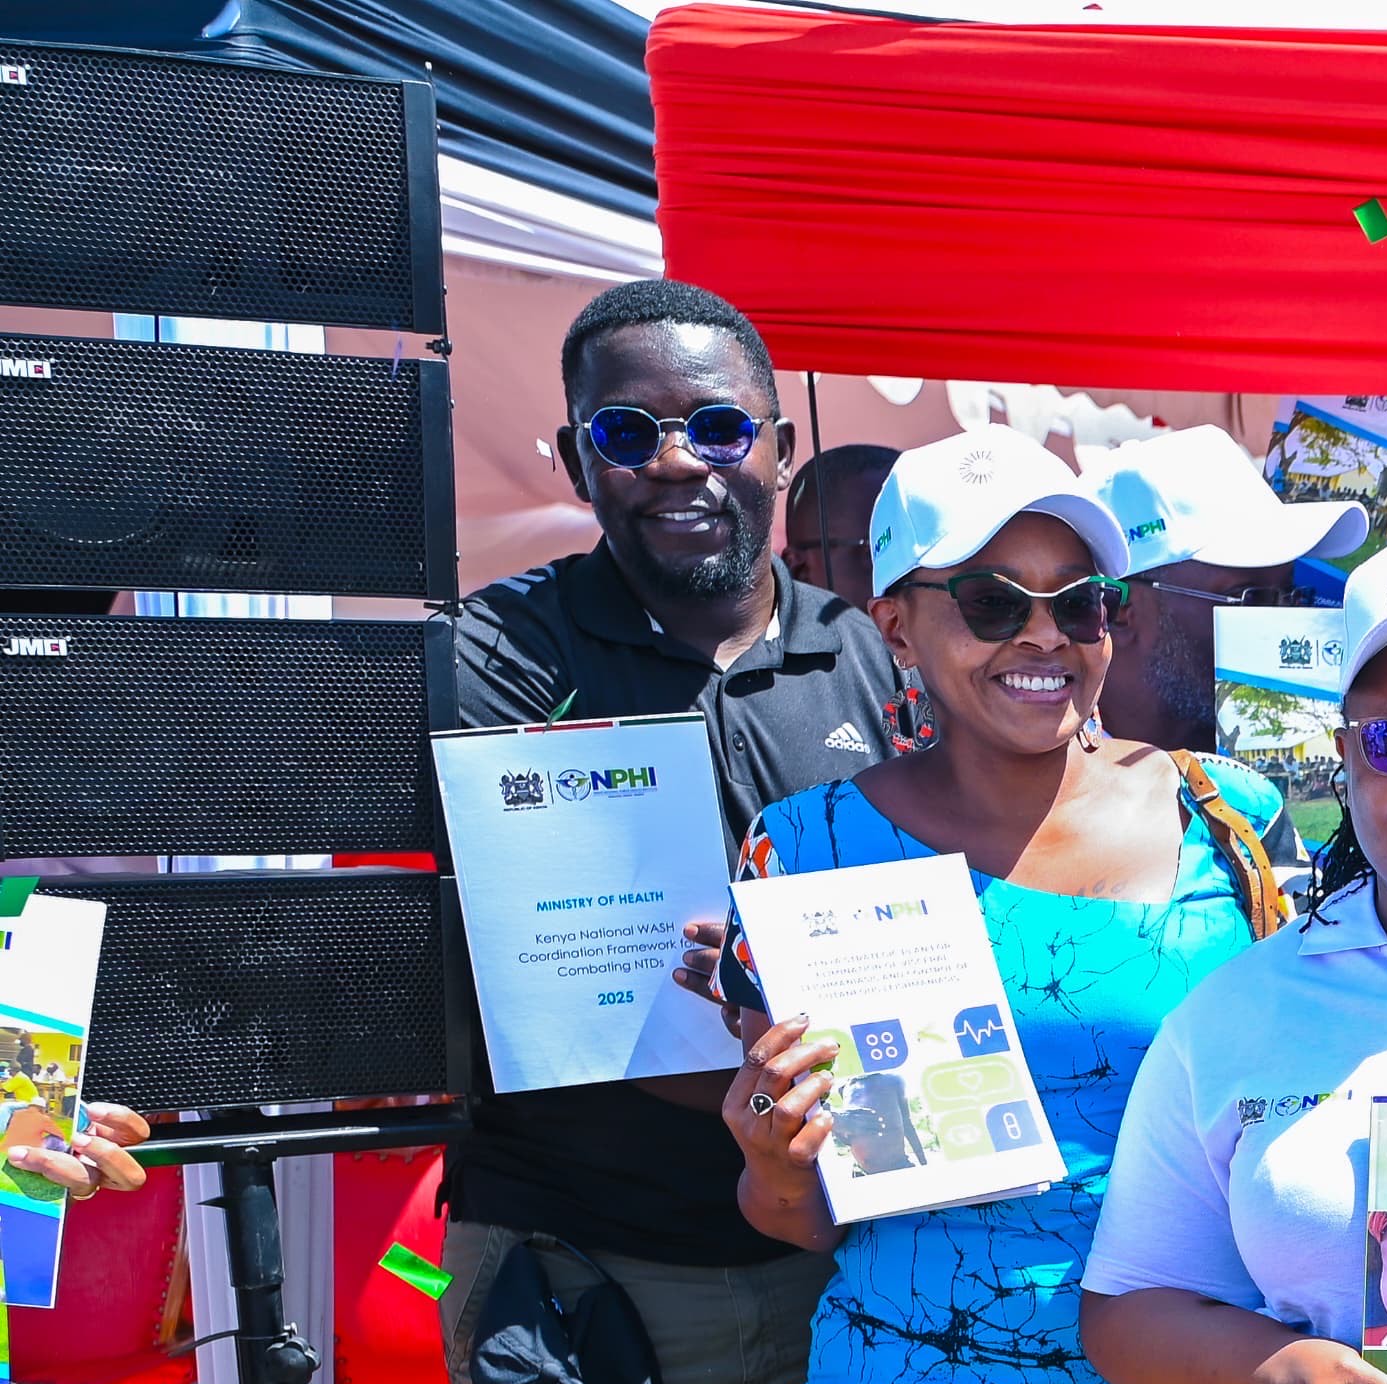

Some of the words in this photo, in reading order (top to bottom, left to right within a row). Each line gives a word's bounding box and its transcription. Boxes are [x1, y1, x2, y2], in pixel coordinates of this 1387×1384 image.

[1129, 518, 1166, 541] NPHI
[824, 737, 870, 755] adidas
[590, 766, 657, 790] NPHI
[536, 897, 593, 912] MINISTRY
[598, 895, 614, 907] OF
[619, 891, 664, 905] HEALTH
[875, 900, 928, 921] NPHI
[535, 932, 576, 946] Kenya
[580, 925, 634, 941] National
[637, 921, 675, 935] WASH
[518, 947, 604, 965] Coordination
[607, 938, 676, 956] Framework
[557, 961, 631, 978] Combating
[634, 958, 664, 971] NTDs
[597, 990, 634, 1006] 2025
